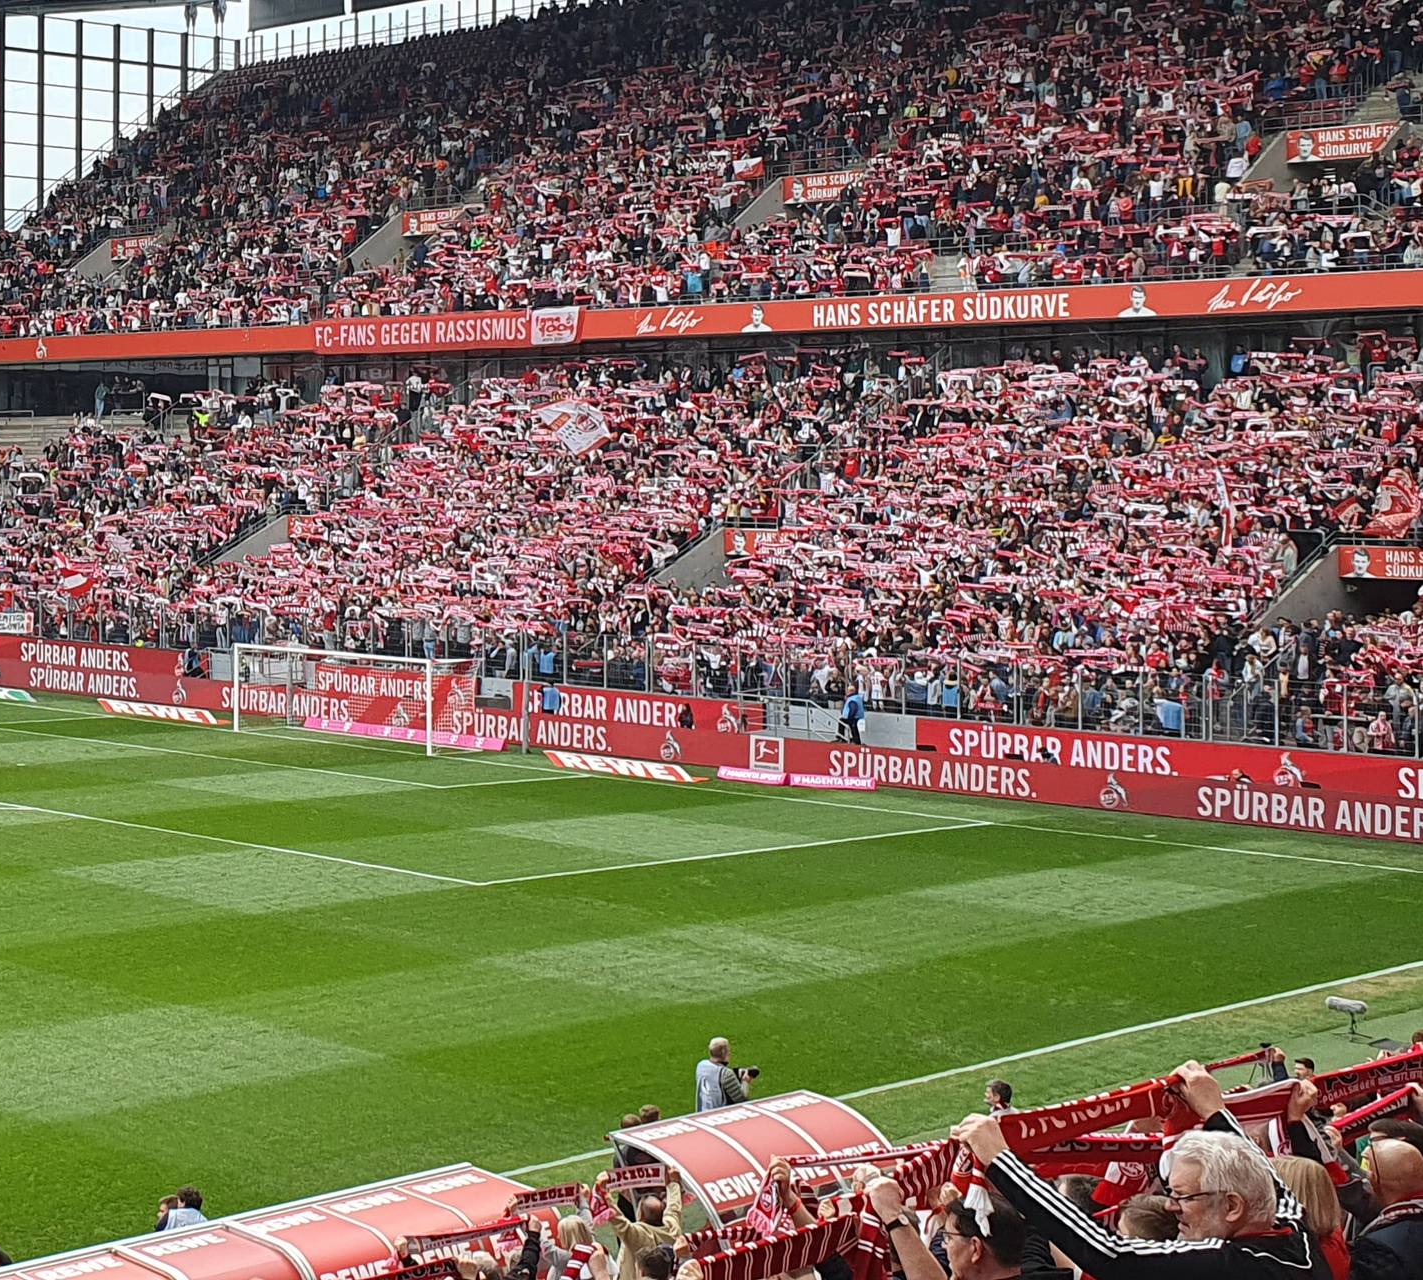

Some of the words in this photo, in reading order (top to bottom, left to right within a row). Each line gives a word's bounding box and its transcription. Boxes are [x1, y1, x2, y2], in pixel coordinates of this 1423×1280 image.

[1318, 130, 1345, 142] HANS
[1318, 141, 1373, 157] SÜDKURVE
[807, 175, 827, 187] HANS
[812, 299, 861, 328] HANS
[865, 292, 957, 325] SCHÄFER
[962, 289, 1070, 322] SÜDKURVE
[314, 322, 376, 347] FC-FANS
[380, 320, 431, 346] GEGEN
[435, 315, 527, 344] RASSISMUS
[1385, 550, 1415, 563] HANS
[1385, 562, 1423, 577] SÜDKU
[20, 639, 76, 662] SPÜRBAR
[79, 649, 133, 672] ANDERS.
[29, 665, 84, 688] SPÜRBAR
[87, 673, 140, 698] ANDERS.
[317, 669, 376, 696] SPÜRBAR
[110, 699, 203, 722] REWE
[292, 694, 353, 722] ANDERS.
[536, 719, 612, 752] ANDERS.
[556, 751, 683, 781] REWE
[1071, 739, 1179, 776] ANDERS.
[802, 776, 844, 786] MAGENTA
[845, 778, 872, 788] SPORT
[829, 747, 930, 790] SPÜRBAR
[939, 760, 1037, 799] ANDERS.
[1197, 784, 1325, 829] SPÜRBAR
[758, 1094, 821, 1112] REWE
[694, 1107, 761, 1126] REWE
[630, 1122, 698, 1142] REWE
[411, 1173, 487, 1195] REWE
[703, 1171, 761, 1204] REWE
[329, 1191, 407, 1214] REWE
[245, 1211, 327, 1236] REWE
[142, 1233, 227, 1257] REWE
